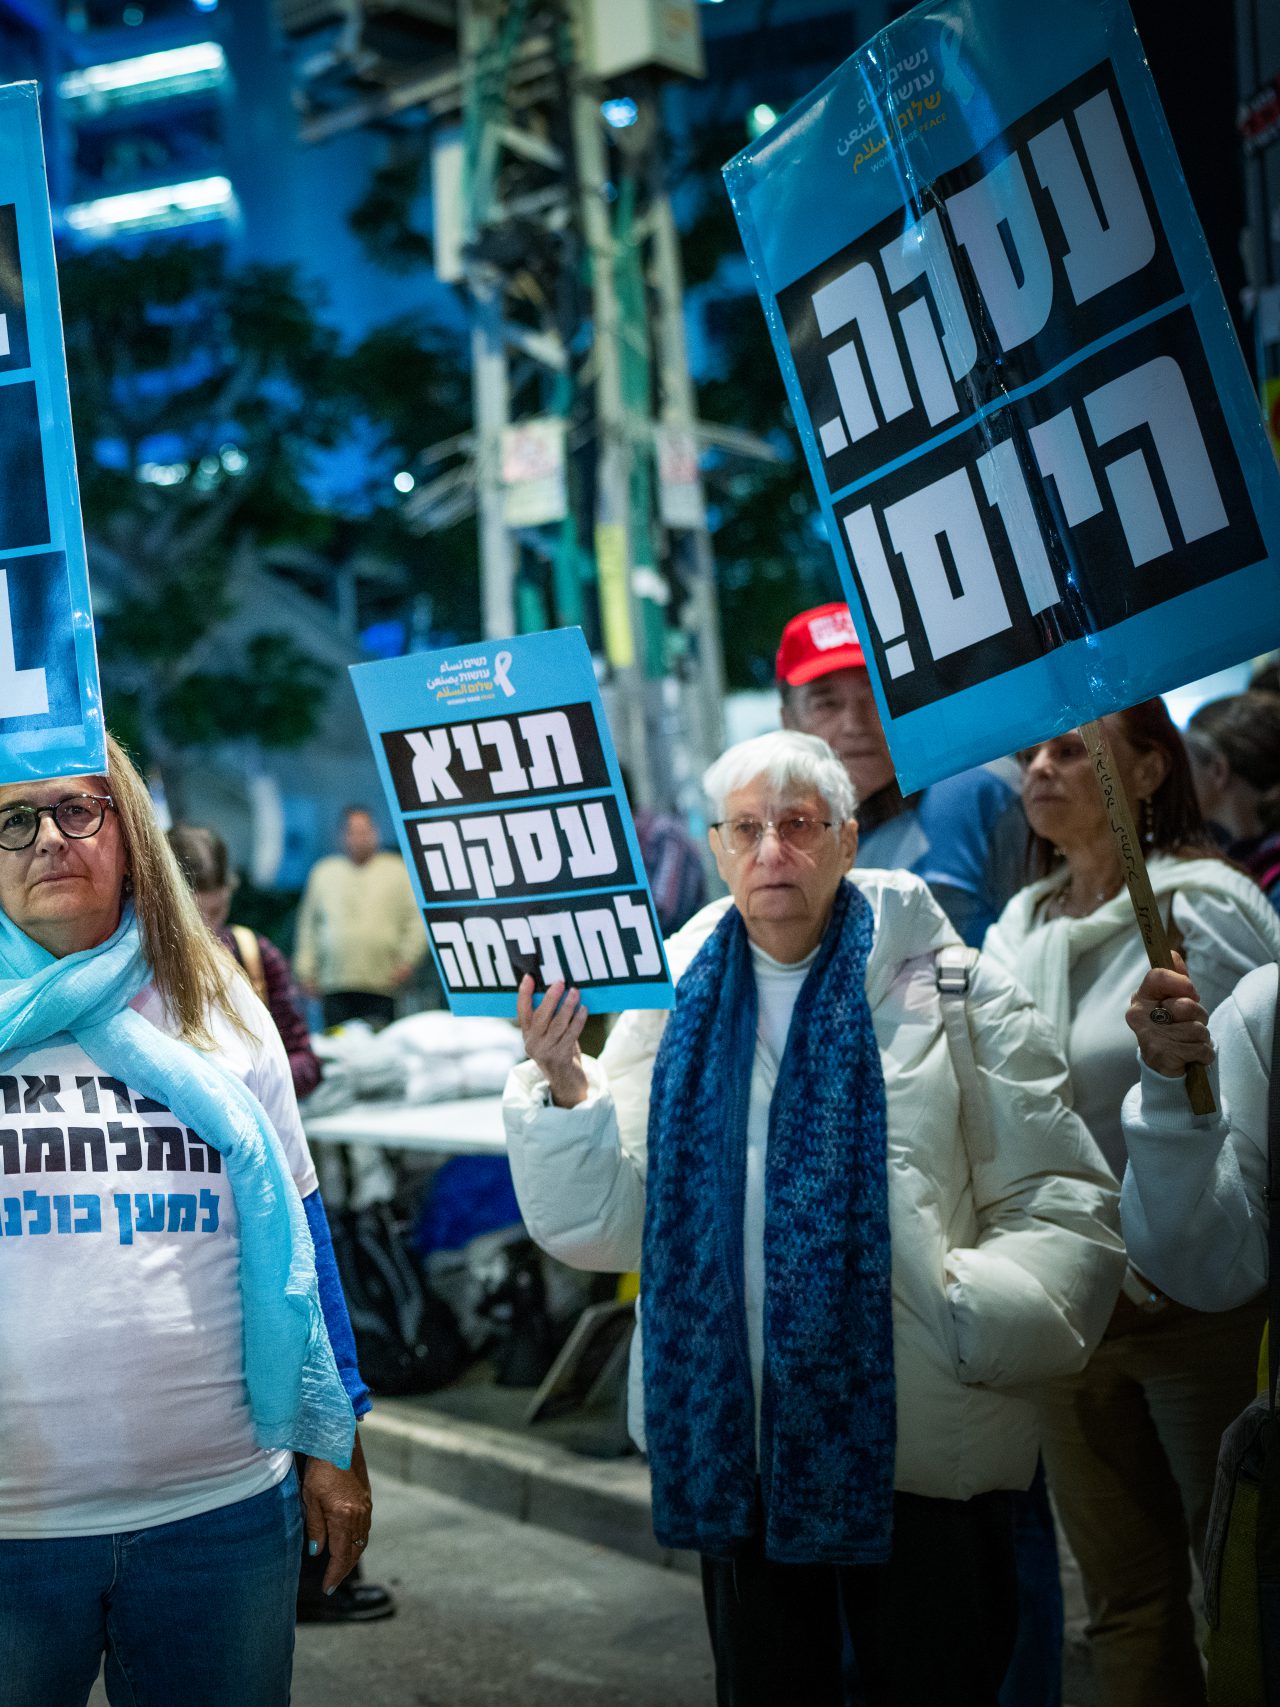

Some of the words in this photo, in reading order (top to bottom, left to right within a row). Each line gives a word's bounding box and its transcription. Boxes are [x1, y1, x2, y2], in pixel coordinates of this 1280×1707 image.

[812, 88, 1156, 459] עסקה.
[842, 354, 1230, 680] היום!
[403, 710, 584, 803] תביא
[416, 802, 619, 900] עסקה
[430, 895, 662, 988] לחתימה
[113, 1189, 220, 1245] למען
